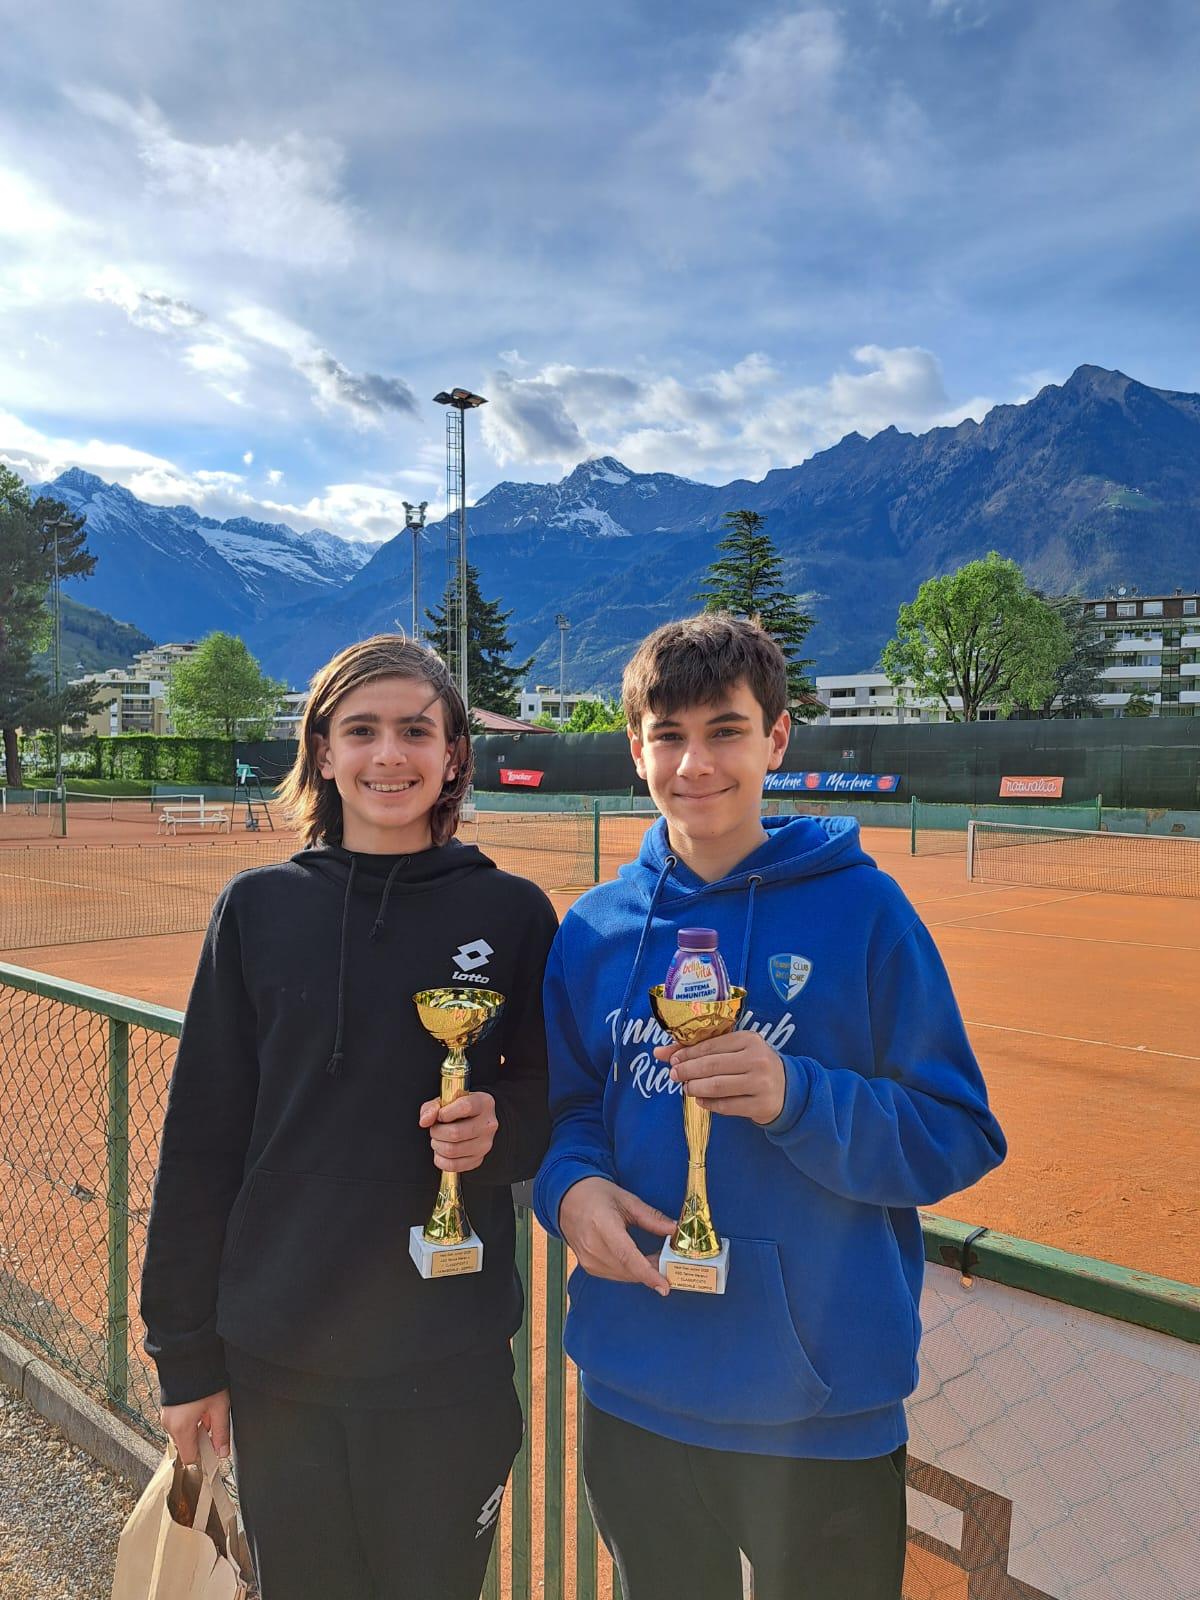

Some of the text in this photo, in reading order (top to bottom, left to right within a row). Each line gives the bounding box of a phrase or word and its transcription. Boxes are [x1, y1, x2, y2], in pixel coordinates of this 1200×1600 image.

[825, 772, 873, 791] Marlene
[675, 988, 717, 1000] IMMUNITARIO
[684, 983, 710, 993] SISTEMA
[735, 1010, 796, 1051] lub
